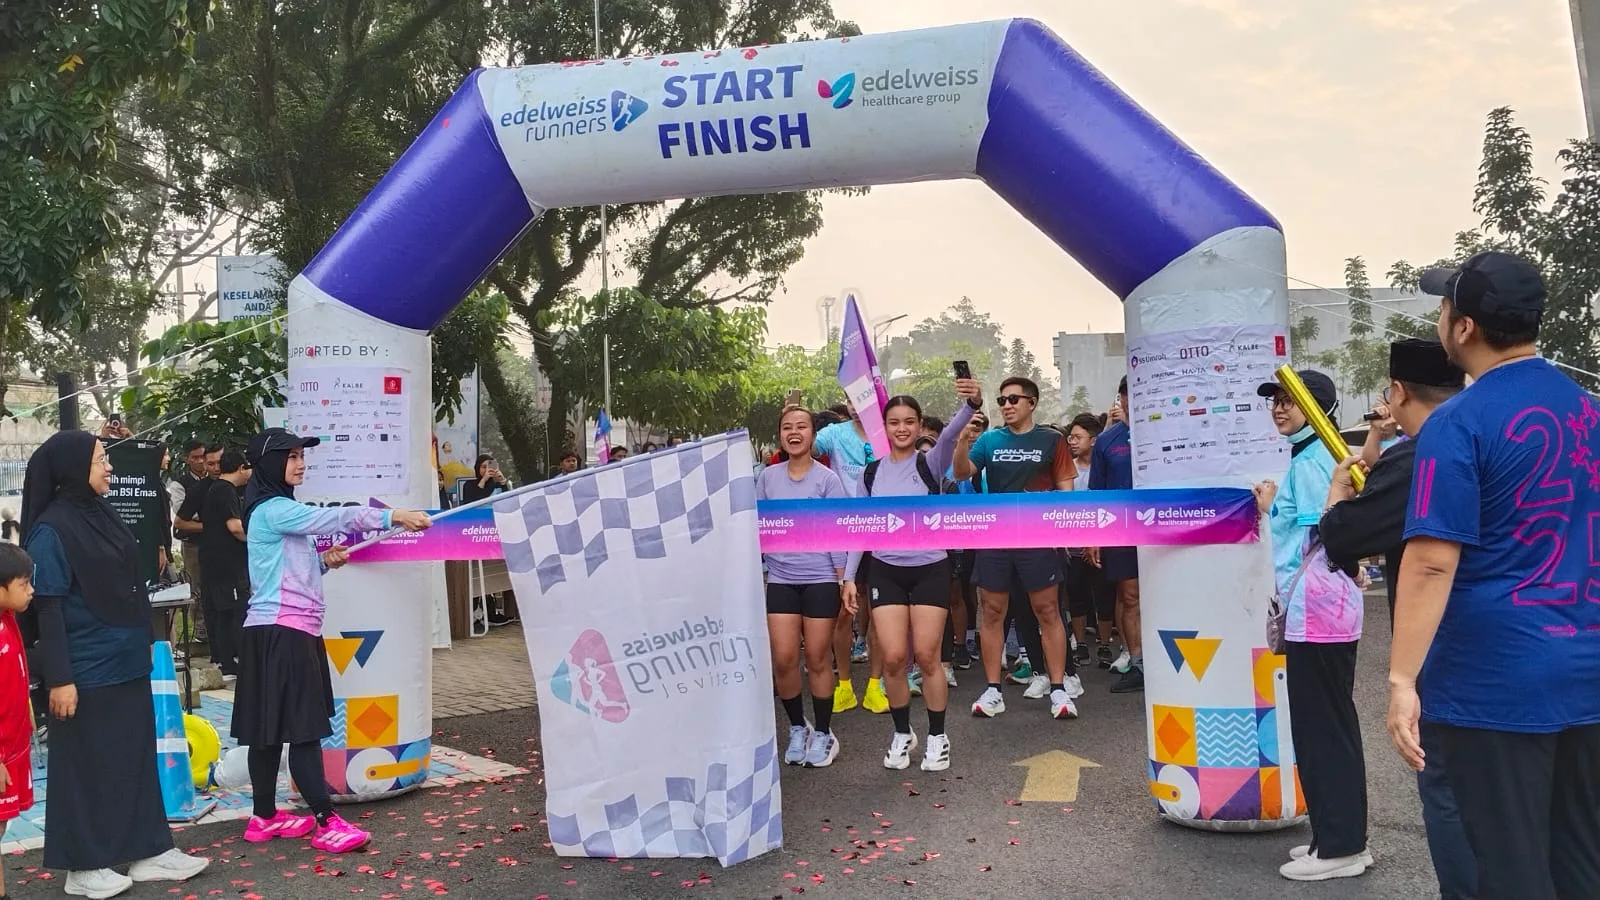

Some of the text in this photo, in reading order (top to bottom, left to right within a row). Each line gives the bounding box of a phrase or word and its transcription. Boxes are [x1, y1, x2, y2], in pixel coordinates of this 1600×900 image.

[861, 66, 978, 92] edelweiss
[662, 64, 804, 108] START
[862, 93, 961, 107] healthcare group
[500, 96, 607, 127] edelweiss
[526, 116, 607, 142] runners
[658, 112, 811, 159] FINISH
[244, 302, 272, 311] ANDA
[359, 345, 379, 356] BY
[1180, 345, 1209, 360] OTTO
[301, 381, 319, 392] OTTO
[992, 455, 1042, 463] LOOPS
[120, 475, 145, 486] mimpi
[120, 487, 133, 497] BSI
[134, 487, 157, 497] Emas
[943, 511, 997, 523] edelweiss
[1042, 508, 1096, 520] edelweiss
[1158, 507, 1216, 518] edelweiss
[836, 514, 886, 525] edelweiss
[1054, 520, 1096, 529] runners
[847, 525, 886, 533] runners
